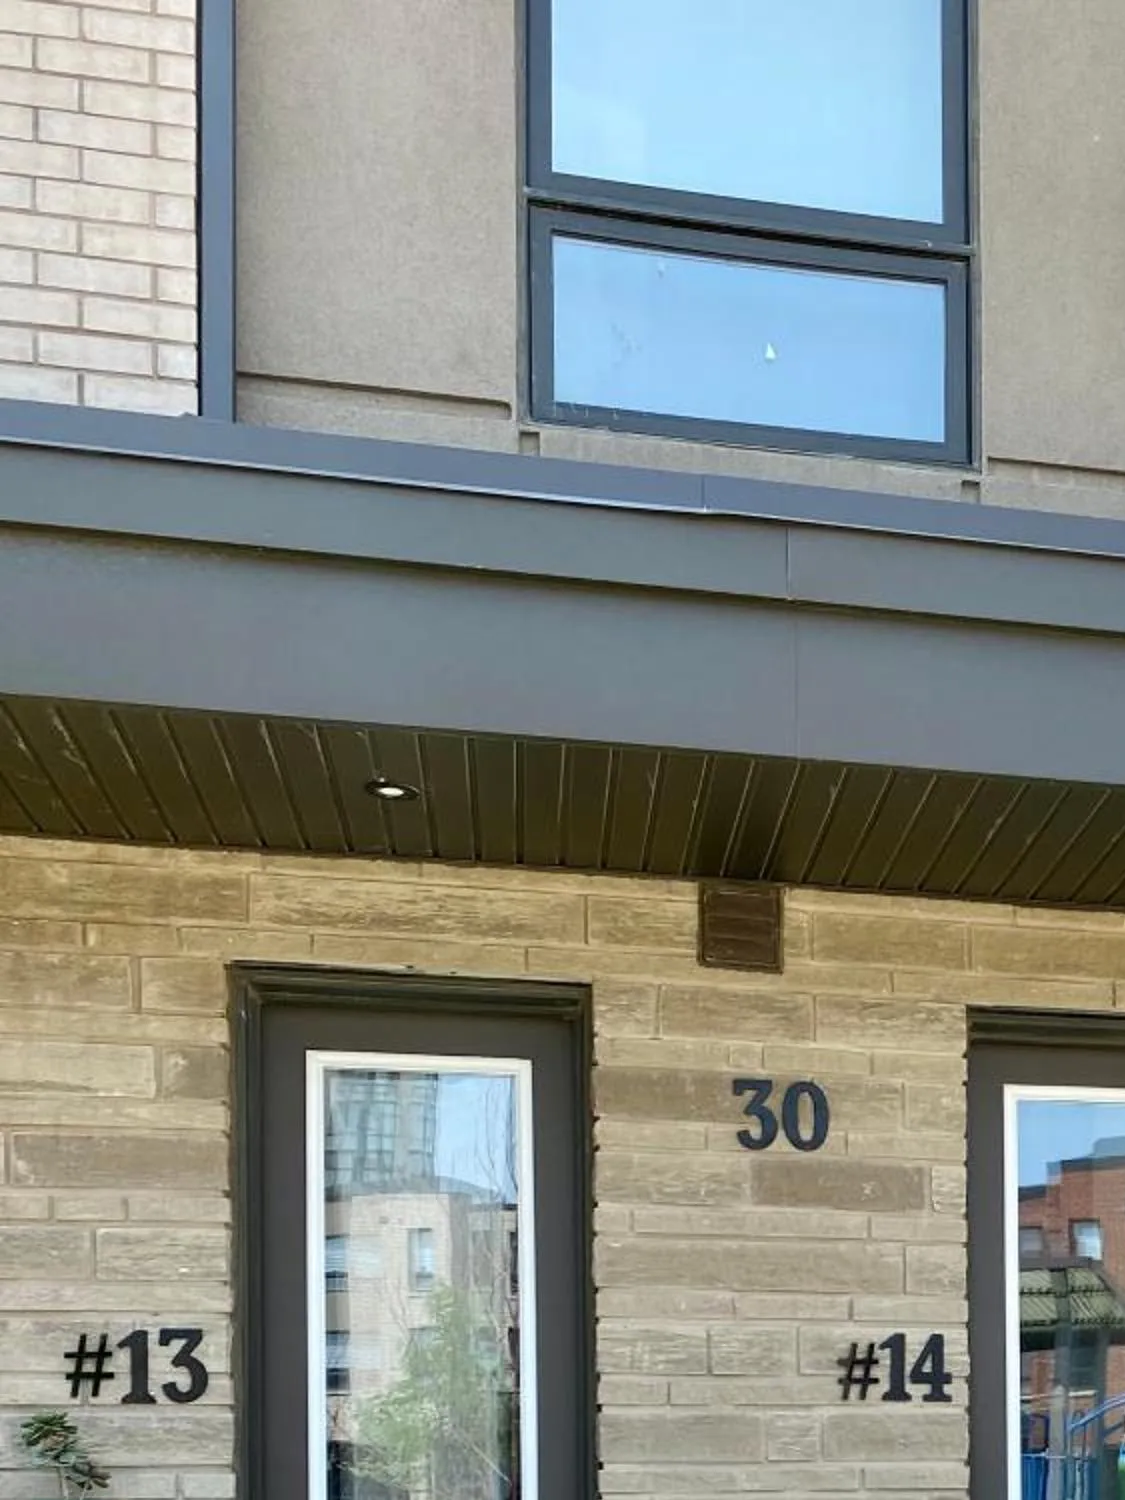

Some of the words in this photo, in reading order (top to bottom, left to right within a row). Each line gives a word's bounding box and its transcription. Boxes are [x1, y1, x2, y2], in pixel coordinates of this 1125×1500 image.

[733, 1079, 829, 1151] 30
[64, 1328, 209, 1404] #13
[837, 1333, 952, 1402] #14
